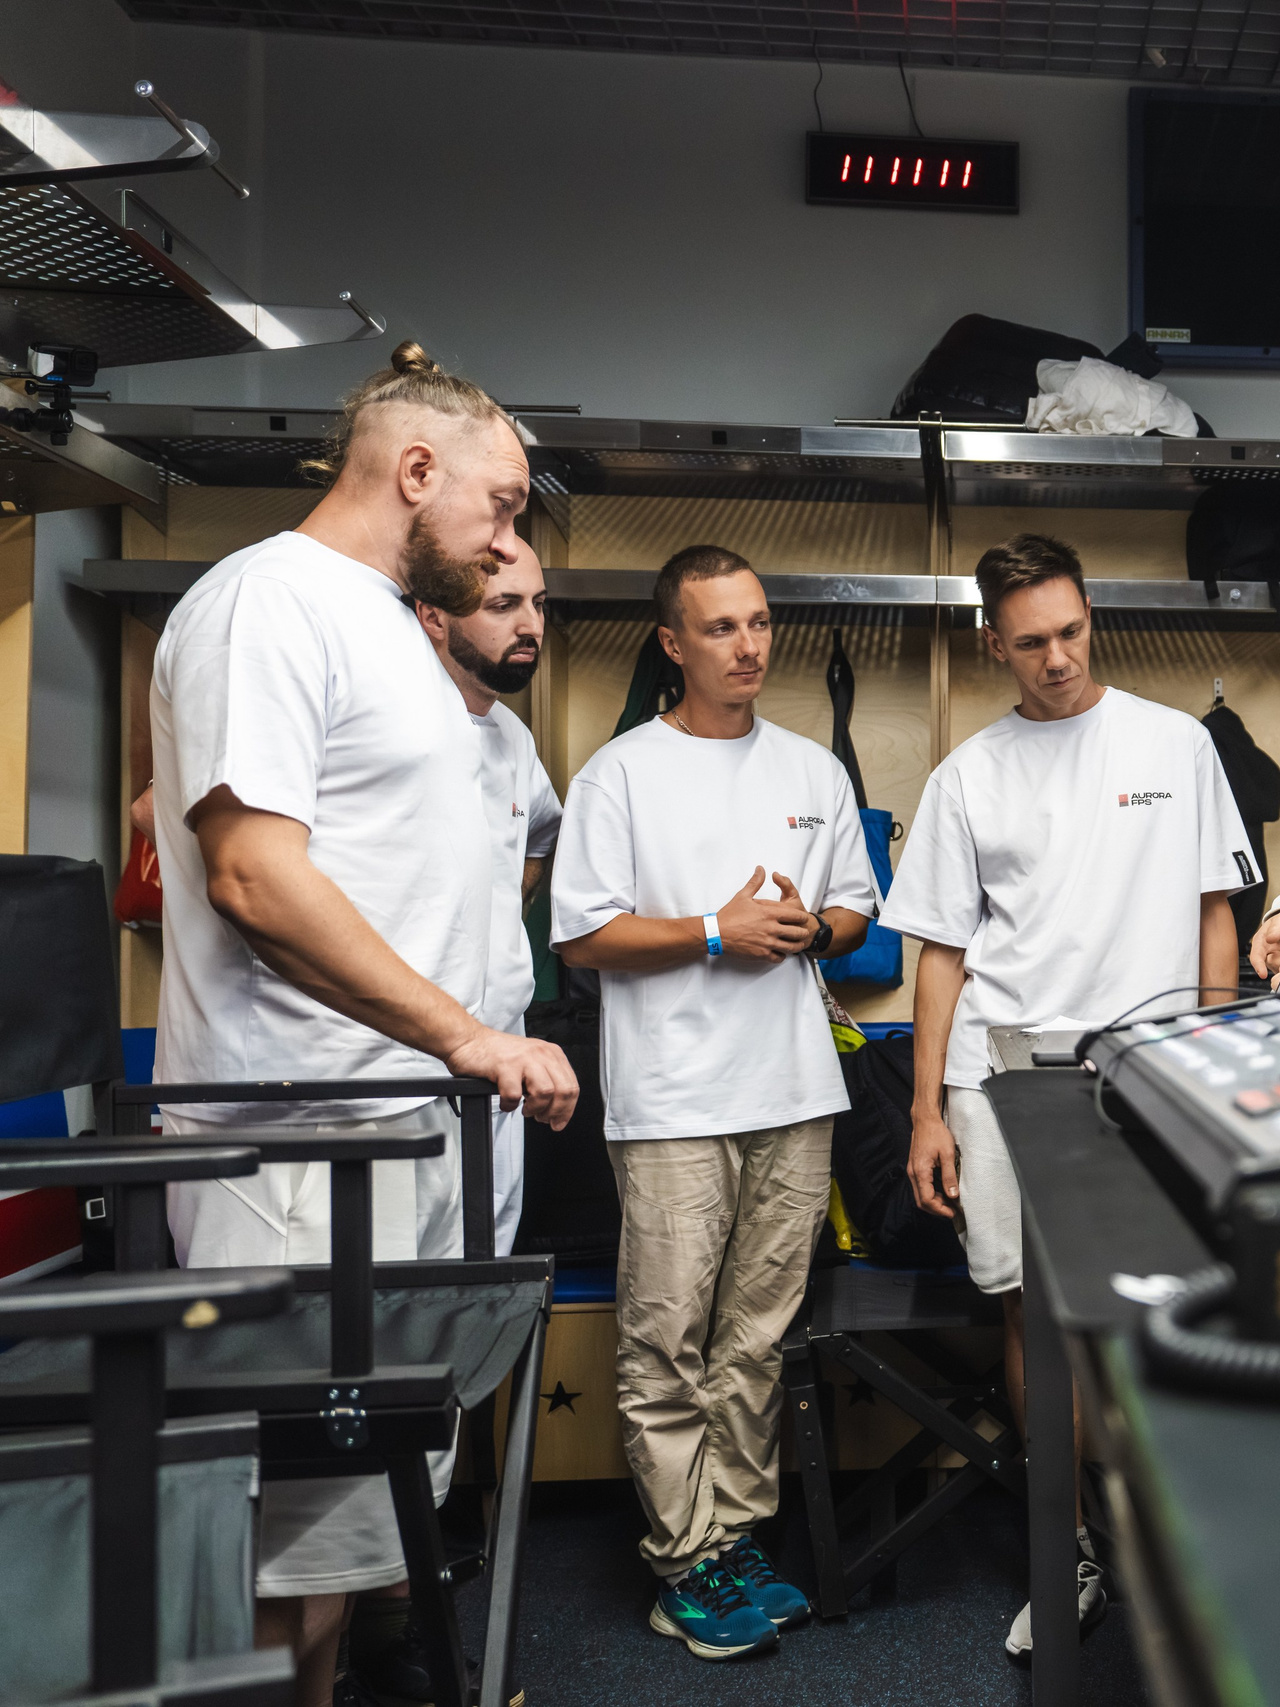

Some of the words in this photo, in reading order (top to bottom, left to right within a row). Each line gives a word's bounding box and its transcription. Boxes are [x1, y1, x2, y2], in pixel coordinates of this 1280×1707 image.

[1147, 330, 1190, 340] ANNAX
[799, 816, 826, 825] AURORA
[799, 822, 814, 830] FPS
